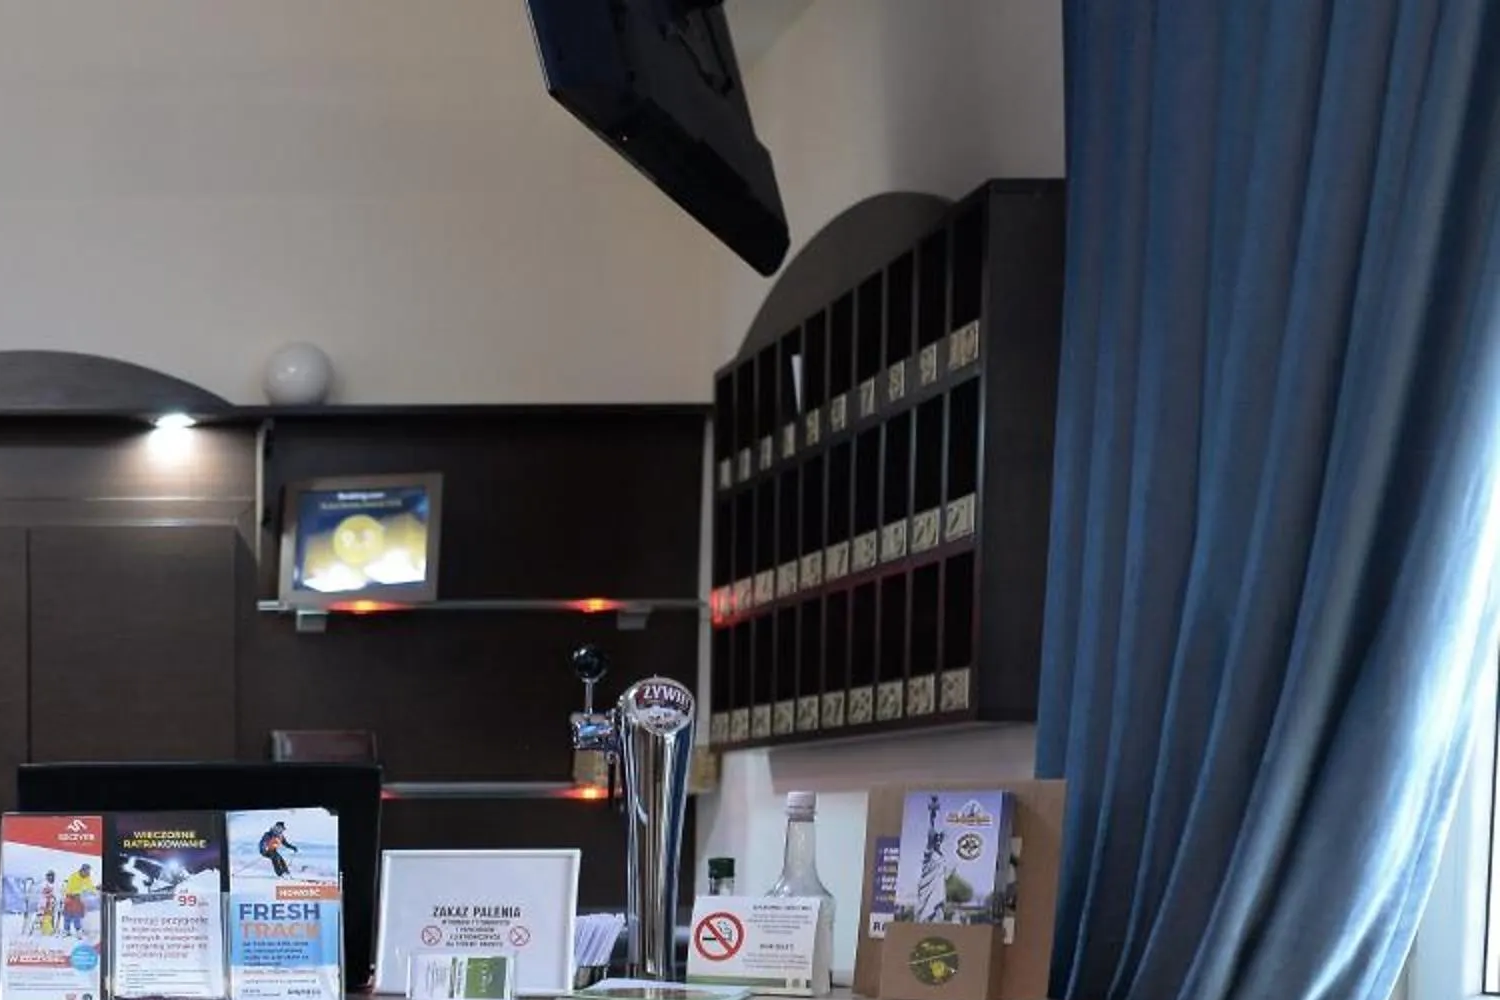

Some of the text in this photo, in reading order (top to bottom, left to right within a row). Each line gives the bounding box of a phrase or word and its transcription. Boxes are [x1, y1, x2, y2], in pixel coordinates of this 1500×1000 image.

[178, 895, 197, 907] 99
[239, 902, 321, 921] FRESH
[432, 905, 521, 918] ZAKAZ PALENIA
